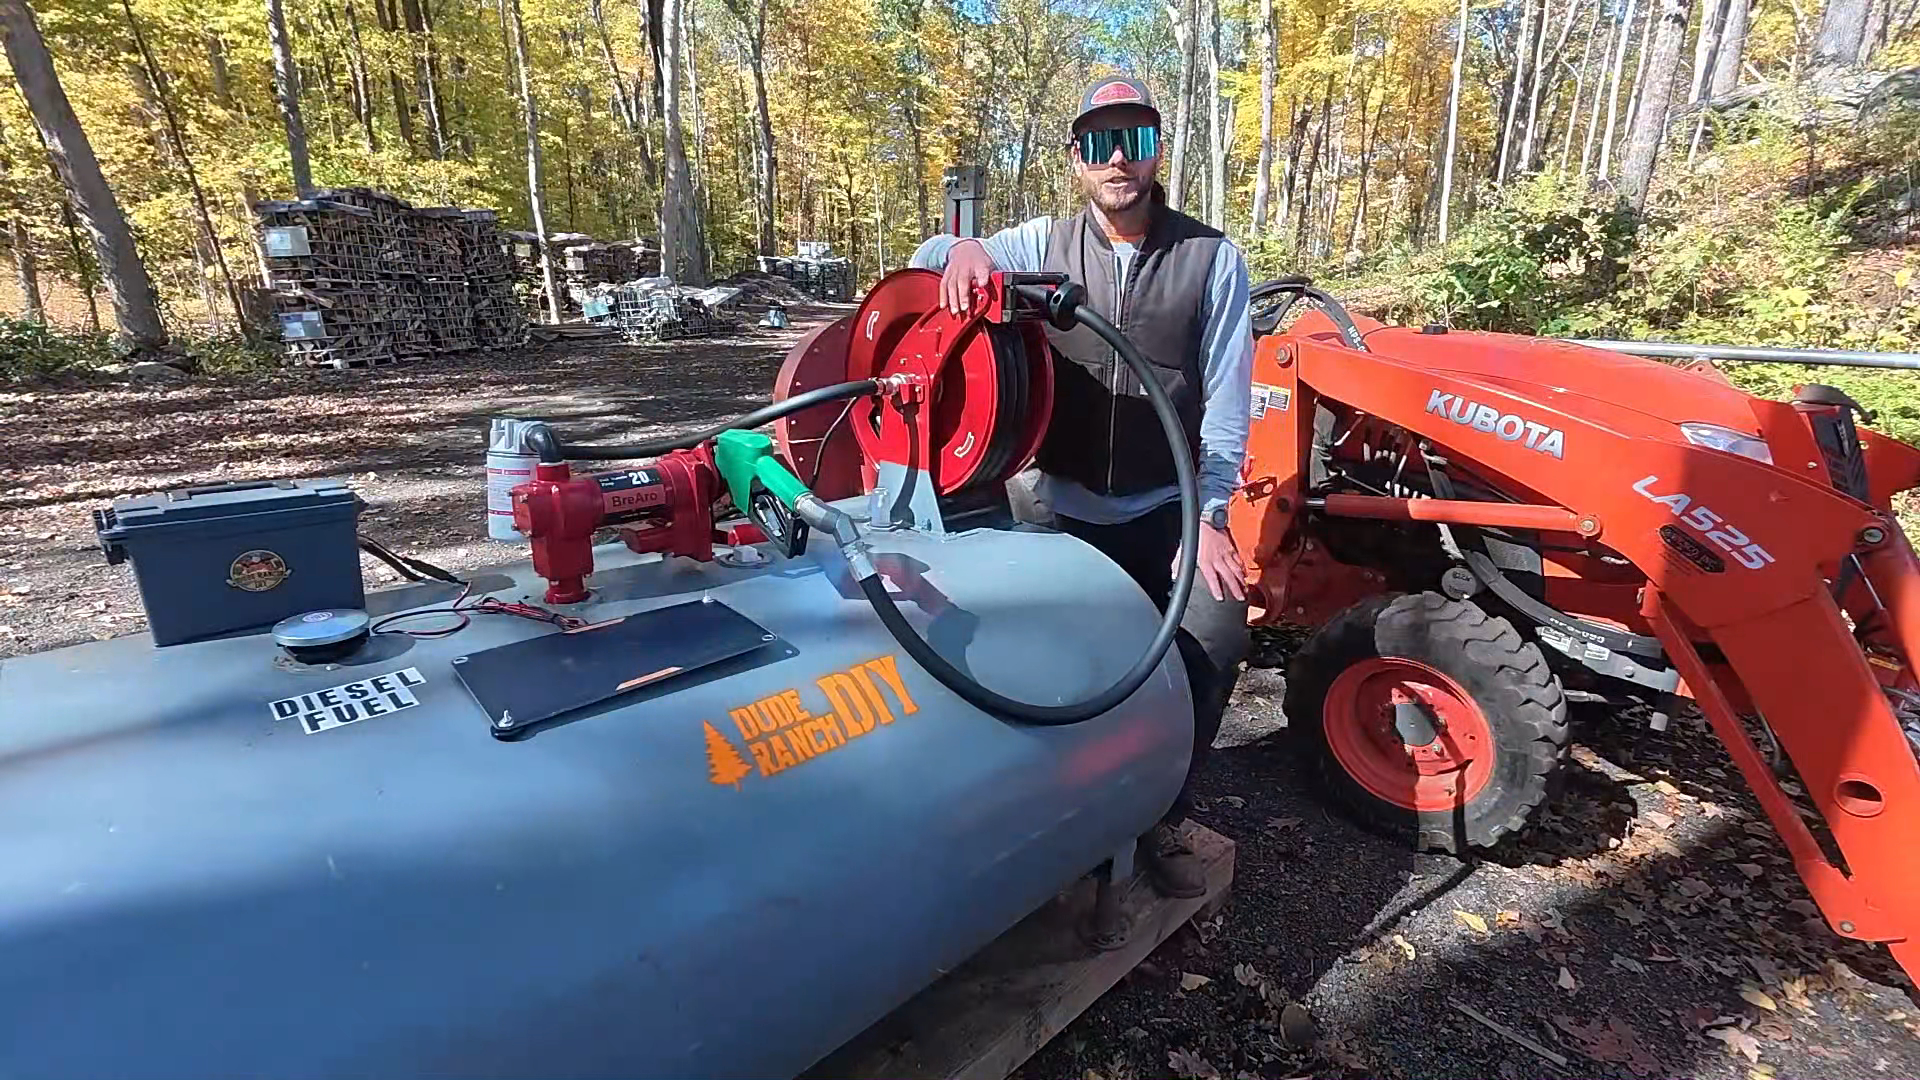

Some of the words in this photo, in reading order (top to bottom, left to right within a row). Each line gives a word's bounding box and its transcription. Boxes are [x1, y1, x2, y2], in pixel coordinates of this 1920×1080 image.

[1425, 388, 1566, 460] KUBOTA
[612, 492, 658, 507] BreAro
[629, 471, 650, 485] 20
[1632, 475, 1775, 570] LA525
[273, 671, 422, 718] DIESEL
[304, 692, 415, 732] FUEL
[728, 688, 811, 741] DUDE
[747, 712, 848, 777] RANCH
[816, 655, 920, 738] DIY
